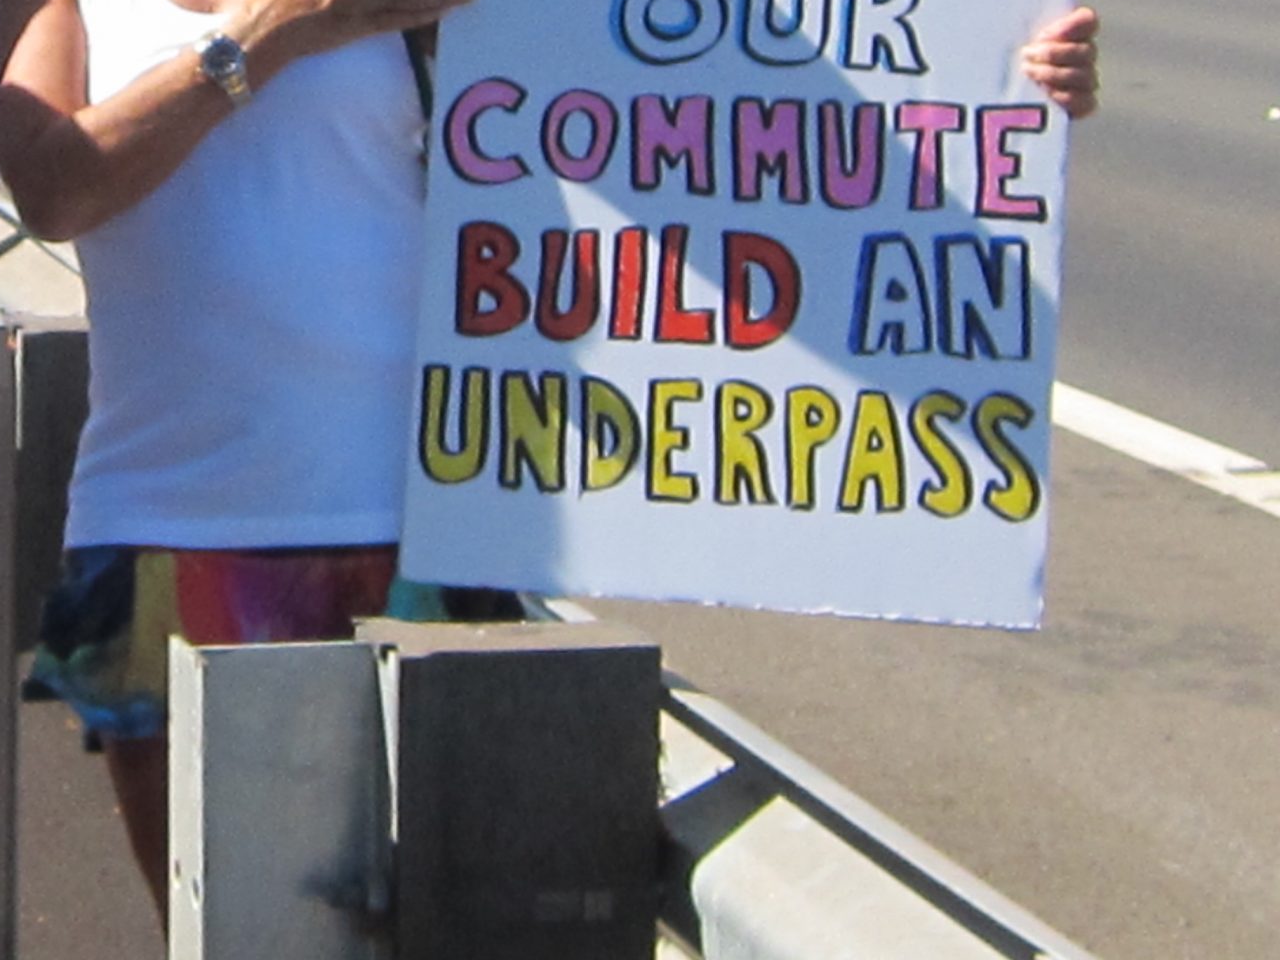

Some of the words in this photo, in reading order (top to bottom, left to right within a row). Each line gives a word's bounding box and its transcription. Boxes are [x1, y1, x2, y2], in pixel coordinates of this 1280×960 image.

[442, 77, 1050, 223] COMMUTE
[453, 221, 803, 351] BUILD
[846, 232, 1033, 361] AN
[419, 364, 1041, 523] UNDERPASS
